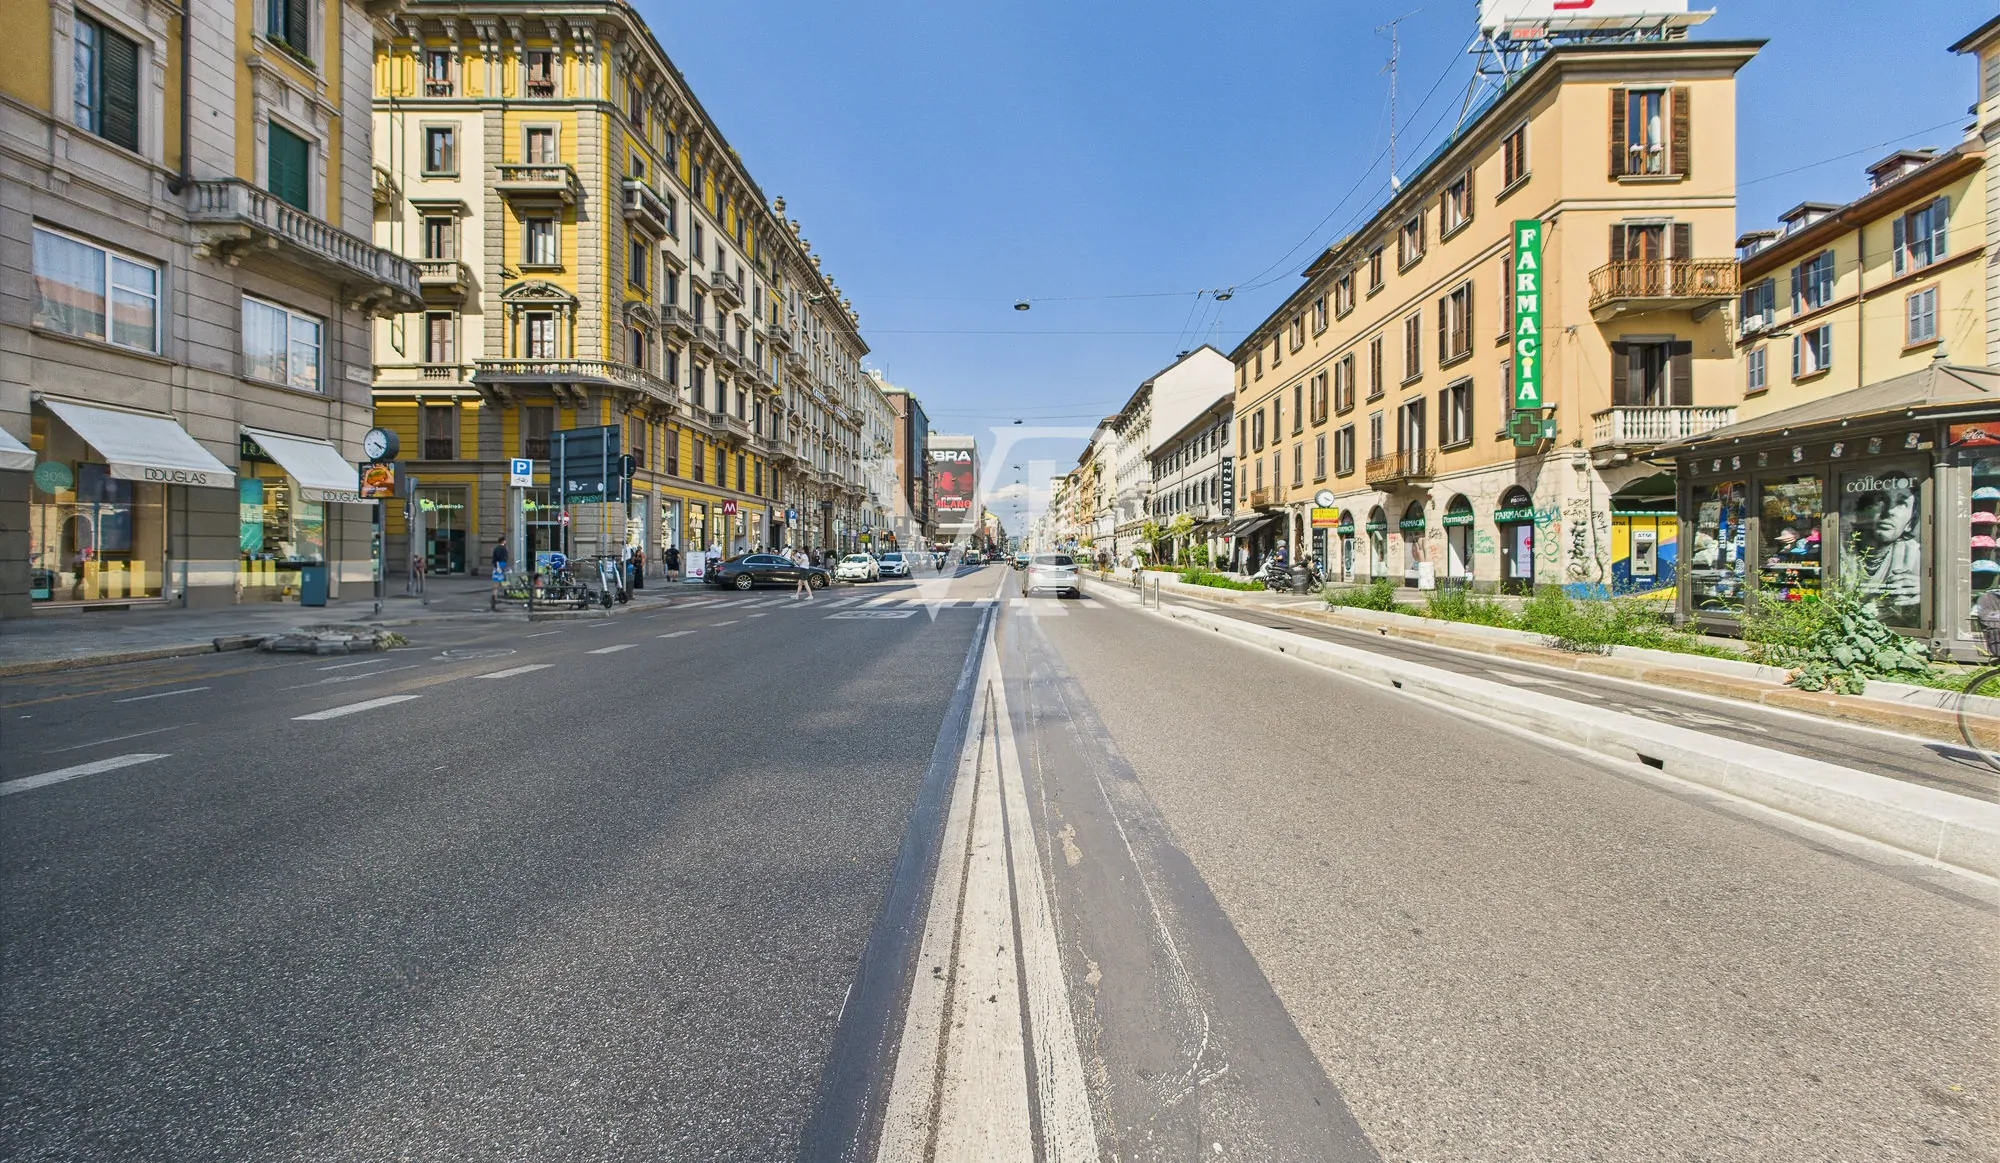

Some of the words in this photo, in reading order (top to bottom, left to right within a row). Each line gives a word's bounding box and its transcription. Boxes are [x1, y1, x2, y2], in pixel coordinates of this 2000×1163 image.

[929, 451, 971, 461] BRA
[516, 462, 527, 473] P
[145, 468, 207, 484] DOUGLAS
[1223, 461, 1232, 504] NOVE25
[724, 503, 736, 512] M
